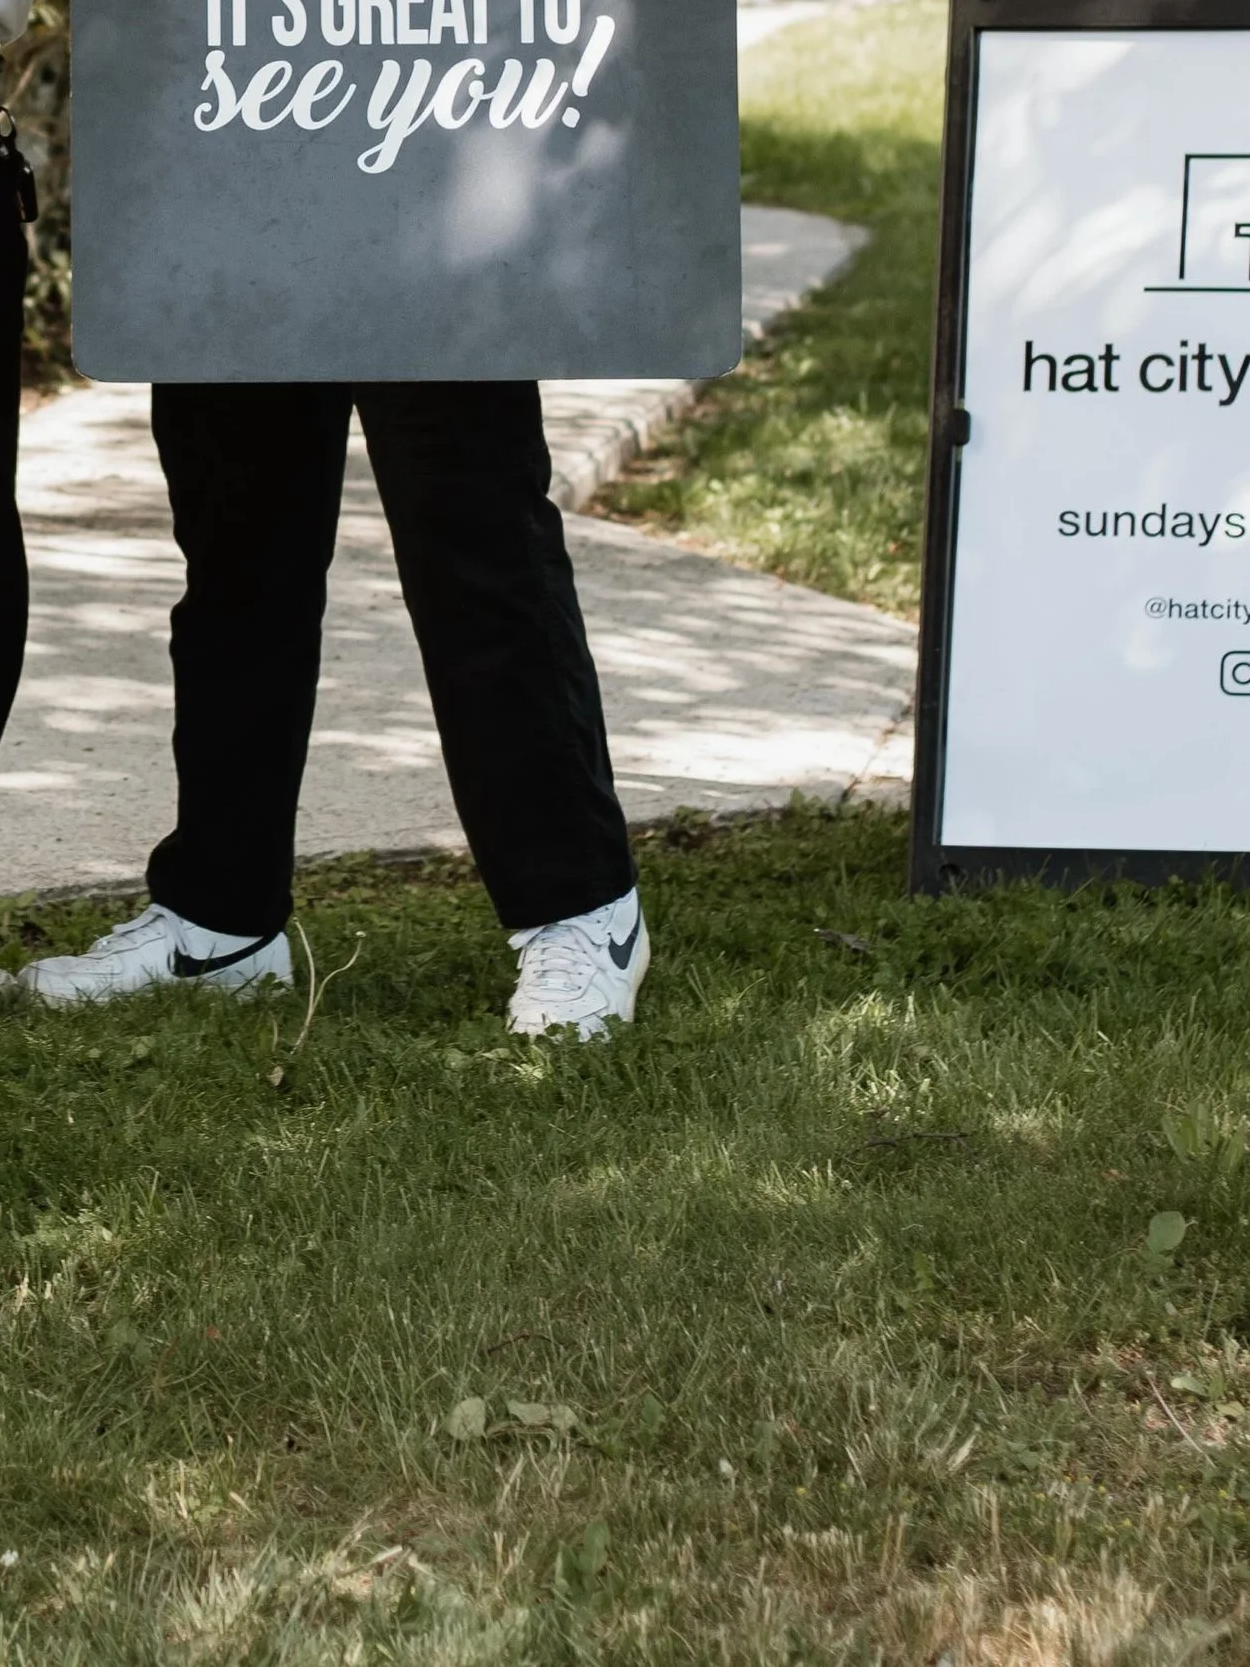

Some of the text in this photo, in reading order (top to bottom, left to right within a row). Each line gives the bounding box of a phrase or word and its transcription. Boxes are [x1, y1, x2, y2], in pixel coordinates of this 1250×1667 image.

[193, 15, 616, 175] see you!
[1023, 339, 1250, 406] hat city
[1058, 502, 1246, 547] sundays
